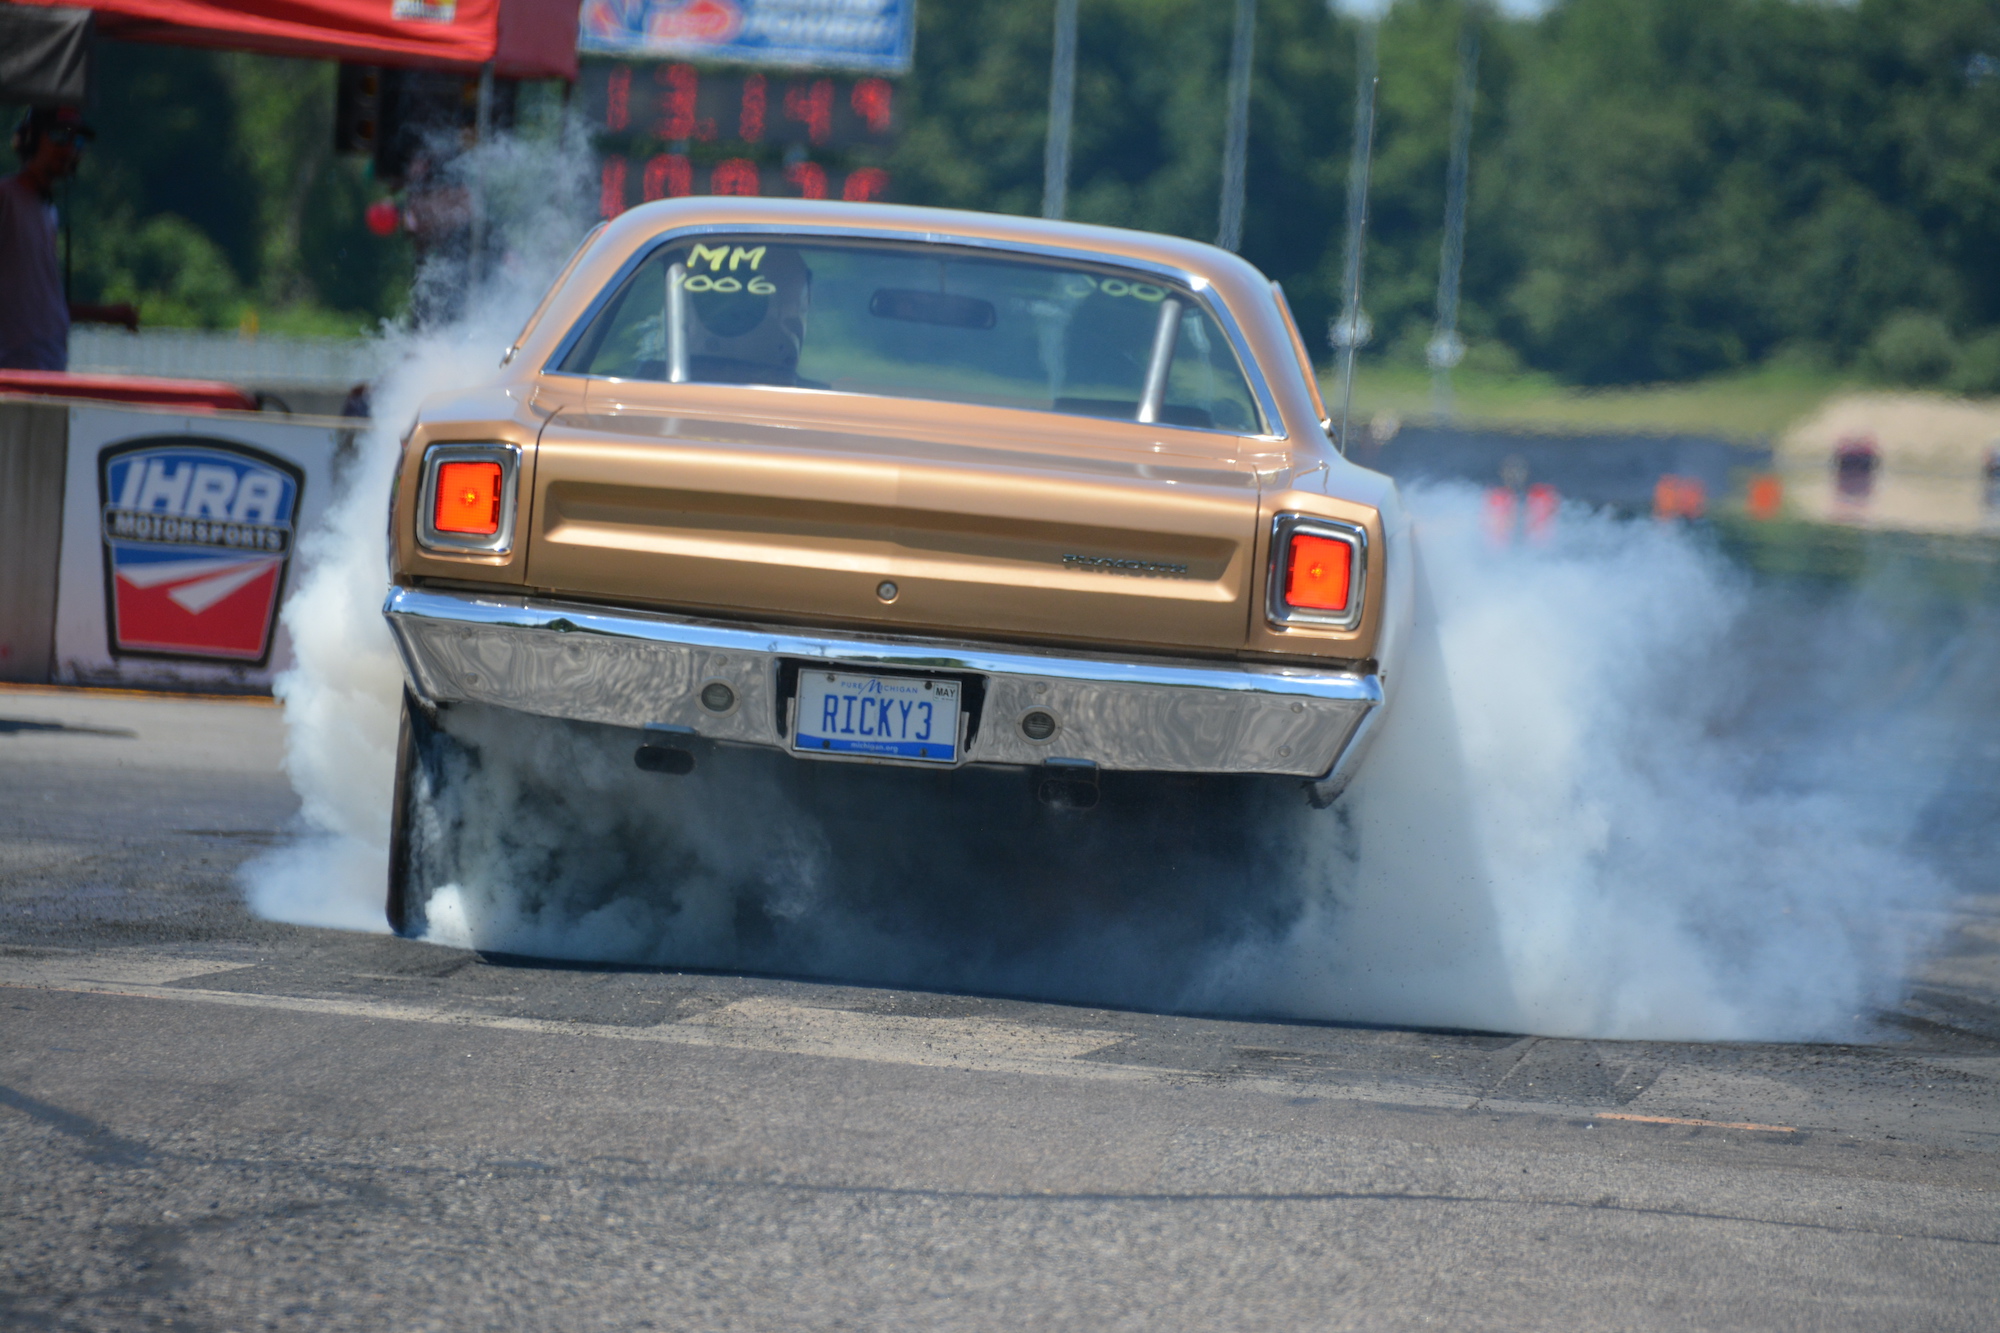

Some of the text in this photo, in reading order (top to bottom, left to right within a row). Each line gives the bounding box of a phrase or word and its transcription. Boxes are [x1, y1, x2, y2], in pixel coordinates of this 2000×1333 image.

[686, 243, 767, 272] MM
[118, 457, 284, 526] IHRA
[114, 513, 282, 550] MOTORSPORTS
[840, 678, 919, 695] PURE MICHIGAN
[935, 687, 956, 698] MAY
[821, 693, 933, 741] RICKY3
[850, 742, 899, 754] michigan.org
